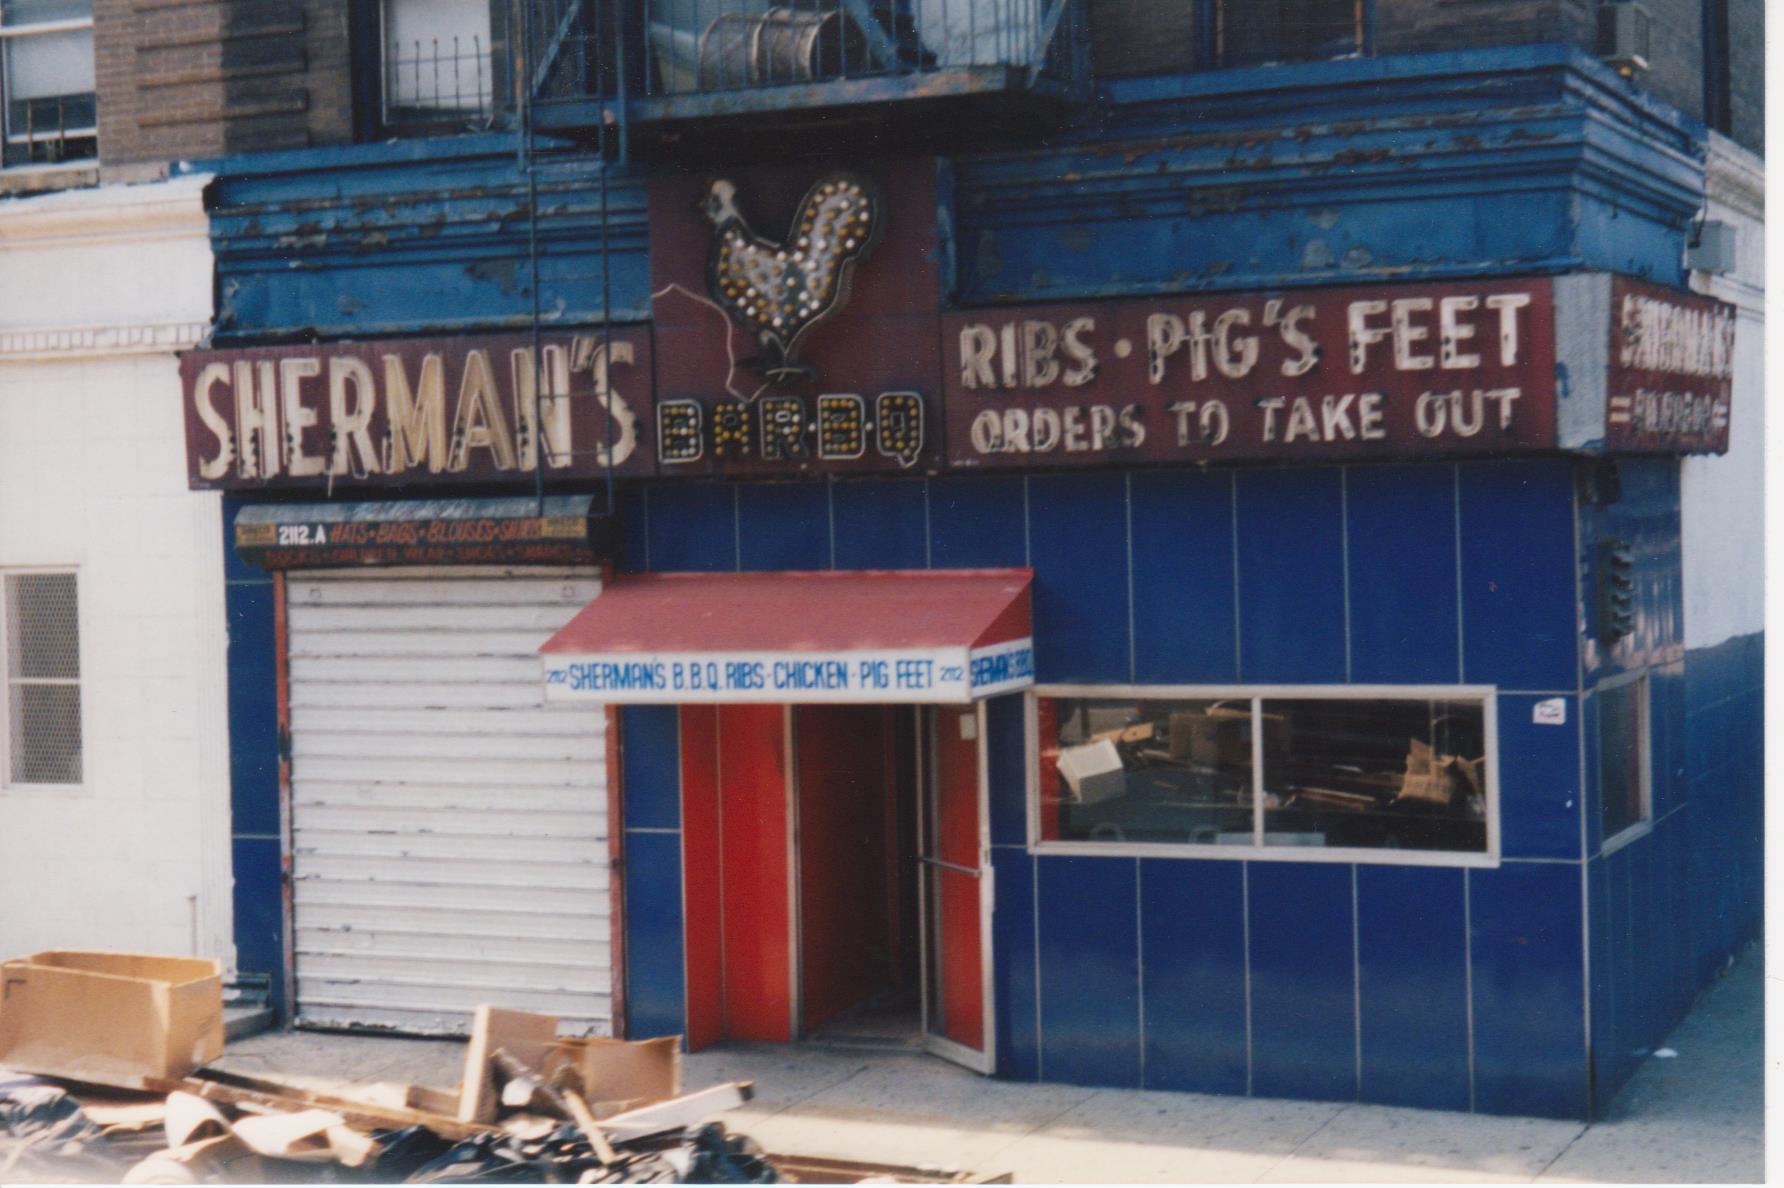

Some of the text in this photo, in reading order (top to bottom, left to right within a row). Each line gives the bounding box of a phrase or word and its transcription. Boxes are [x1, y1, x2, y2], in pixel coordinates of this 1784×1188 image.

[960, 293, 1531, 388] RIBS PIG'S FEET
[194, 334, 639, 480] SHERMAN'S
[970, 387, 1522, 454] ORDERS TO TAKE OUT
[330, 522, 368, 544] HATS
[375, 520, 417, 544] BAGS
[427, 518, 496, 543] BLOUSES
[569, 657, 667, 690] SHERMAN'S
[726, 661, 765, 690] RIBS
[774, 660, 848, 689] CHICKEN
[861, 660, 889, 689] PIG
[896, 659, 934, 689] FEET
